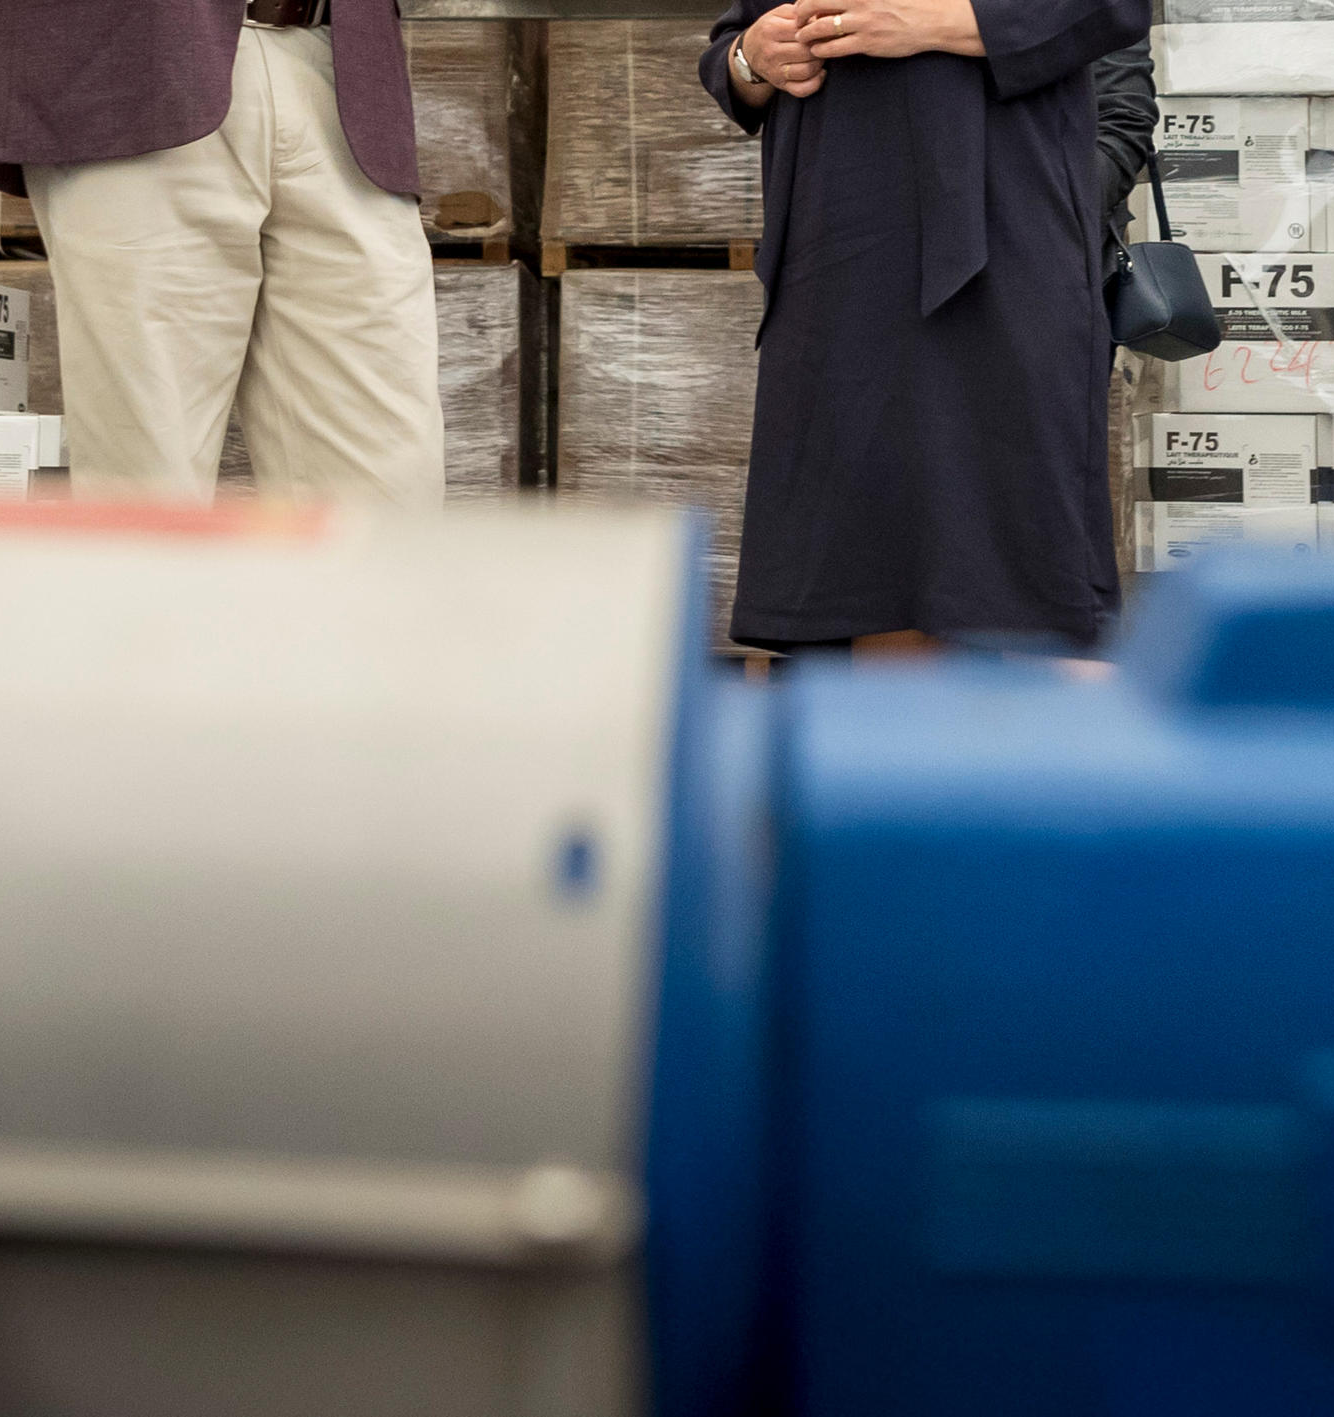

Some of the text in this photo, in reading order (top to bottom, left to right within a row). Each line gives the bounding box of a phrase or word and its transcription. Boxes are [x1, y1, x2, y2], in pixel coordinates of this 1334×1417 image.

[1163, 114, 1216, 134] F-75
[1220, 264, 1316, 299] F-75
[1166, 431, 1219, 452] F-75
